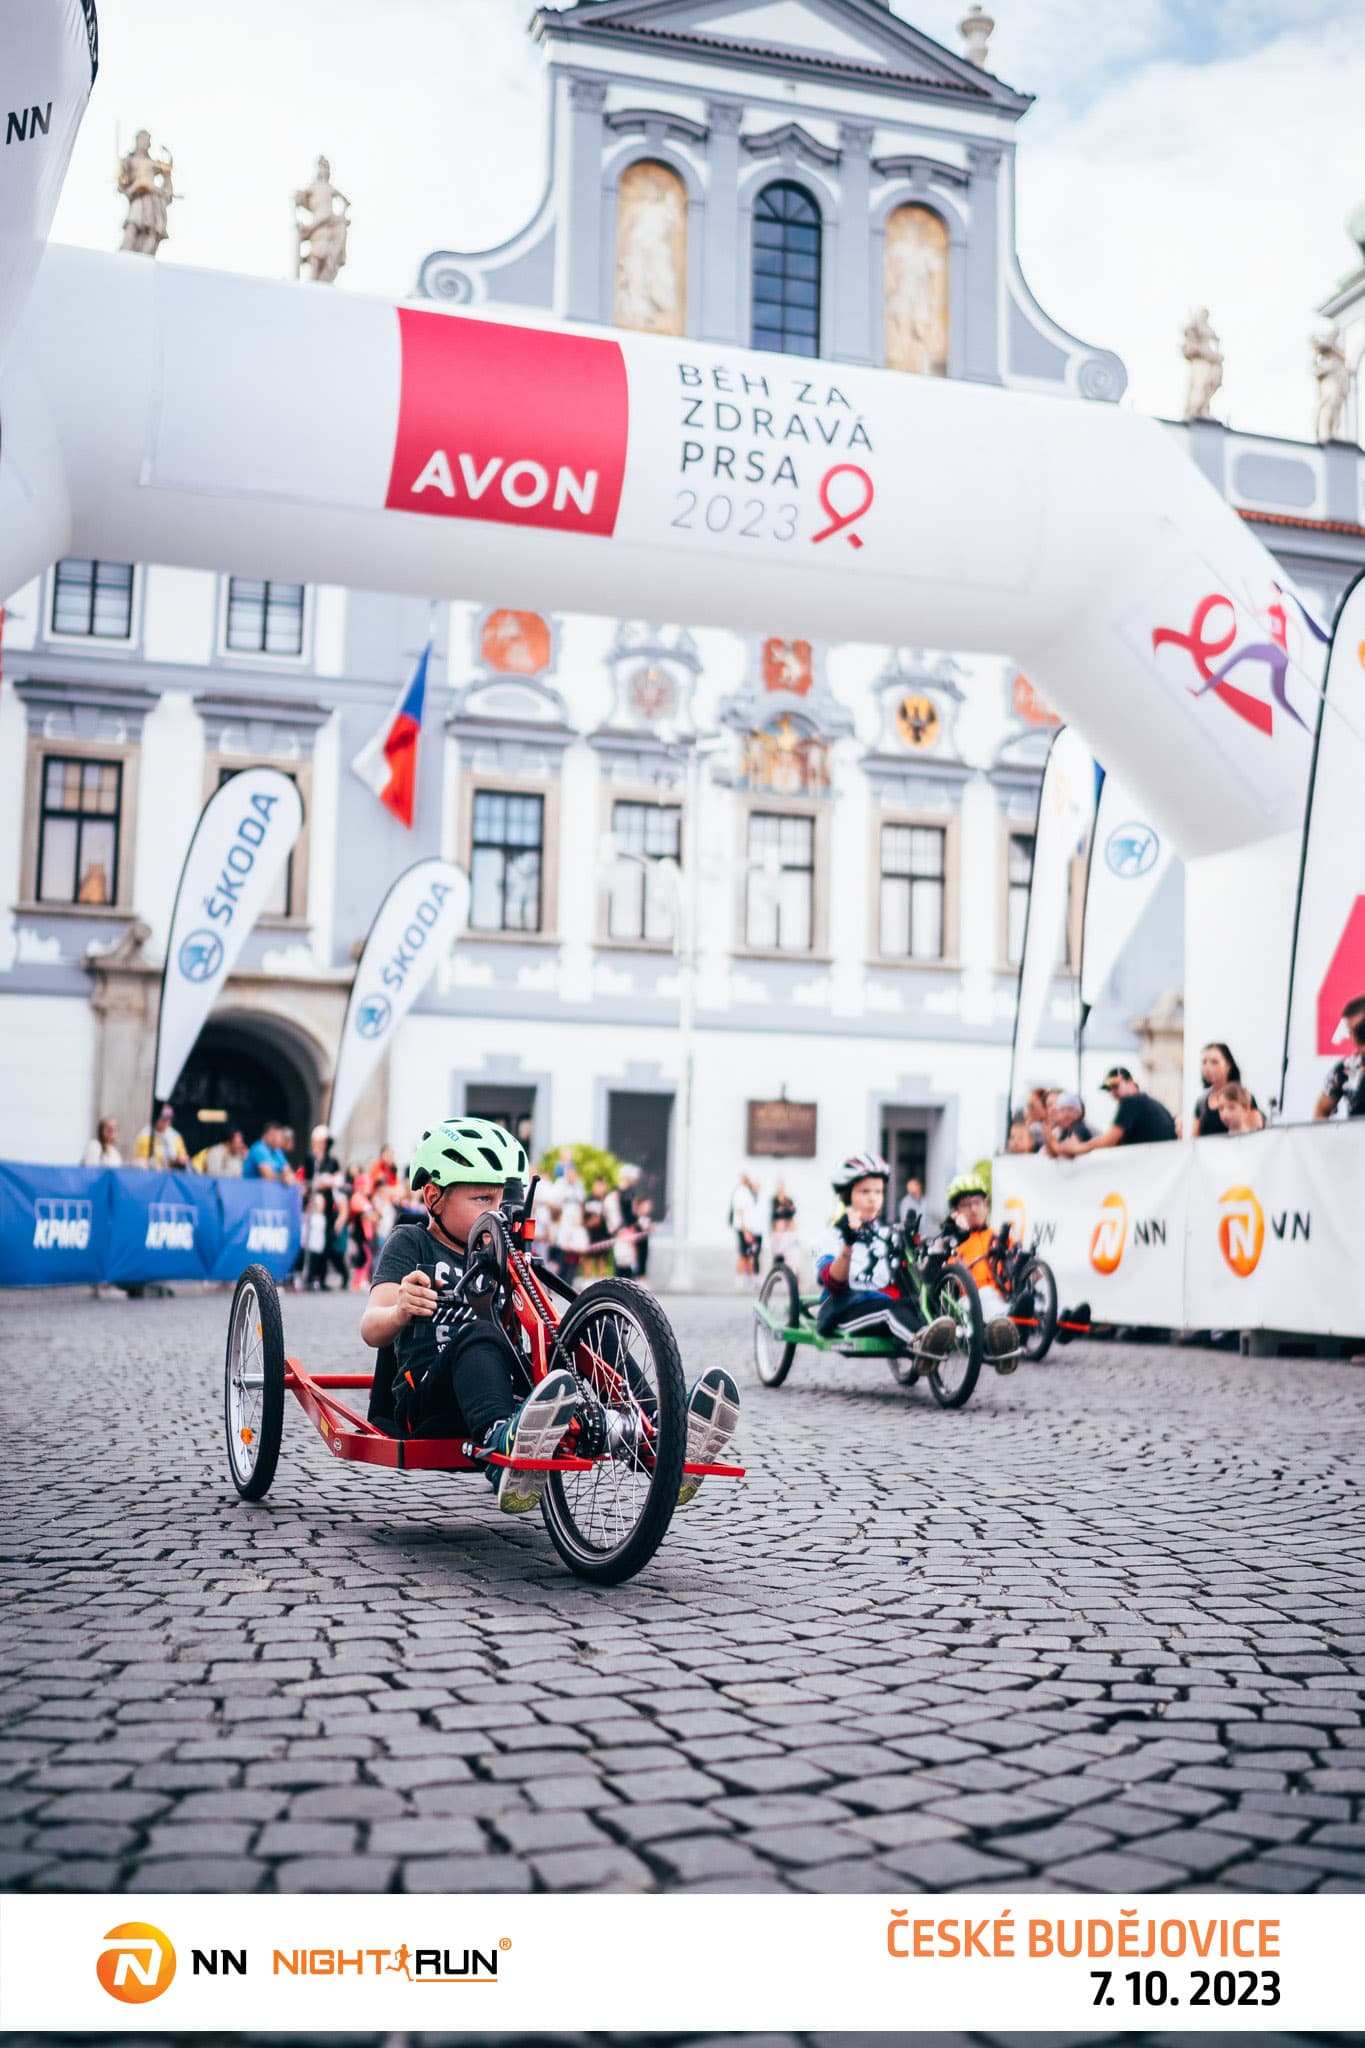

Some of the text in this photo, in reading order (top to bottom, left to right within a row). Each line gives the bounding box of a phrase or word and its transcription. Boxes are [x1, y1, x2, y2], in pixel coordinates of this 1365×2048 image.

[6, 102, 52, 145] NN
[792, 380, 852, 409] ZA
[681, 396, 874, 452] ZDRAVÁ
[410, 449, 599, 515] AVON
[680, 441, 799, 488] PRSA
[670, 489, 799, 541] 2023
[203, 793, 279, 927] ŠKODA
[381, 881, 453, 991] ŠKODA
[33, 1219, 91, 1250] KPMG
[1134, 1218, 1167, 1246] NN
